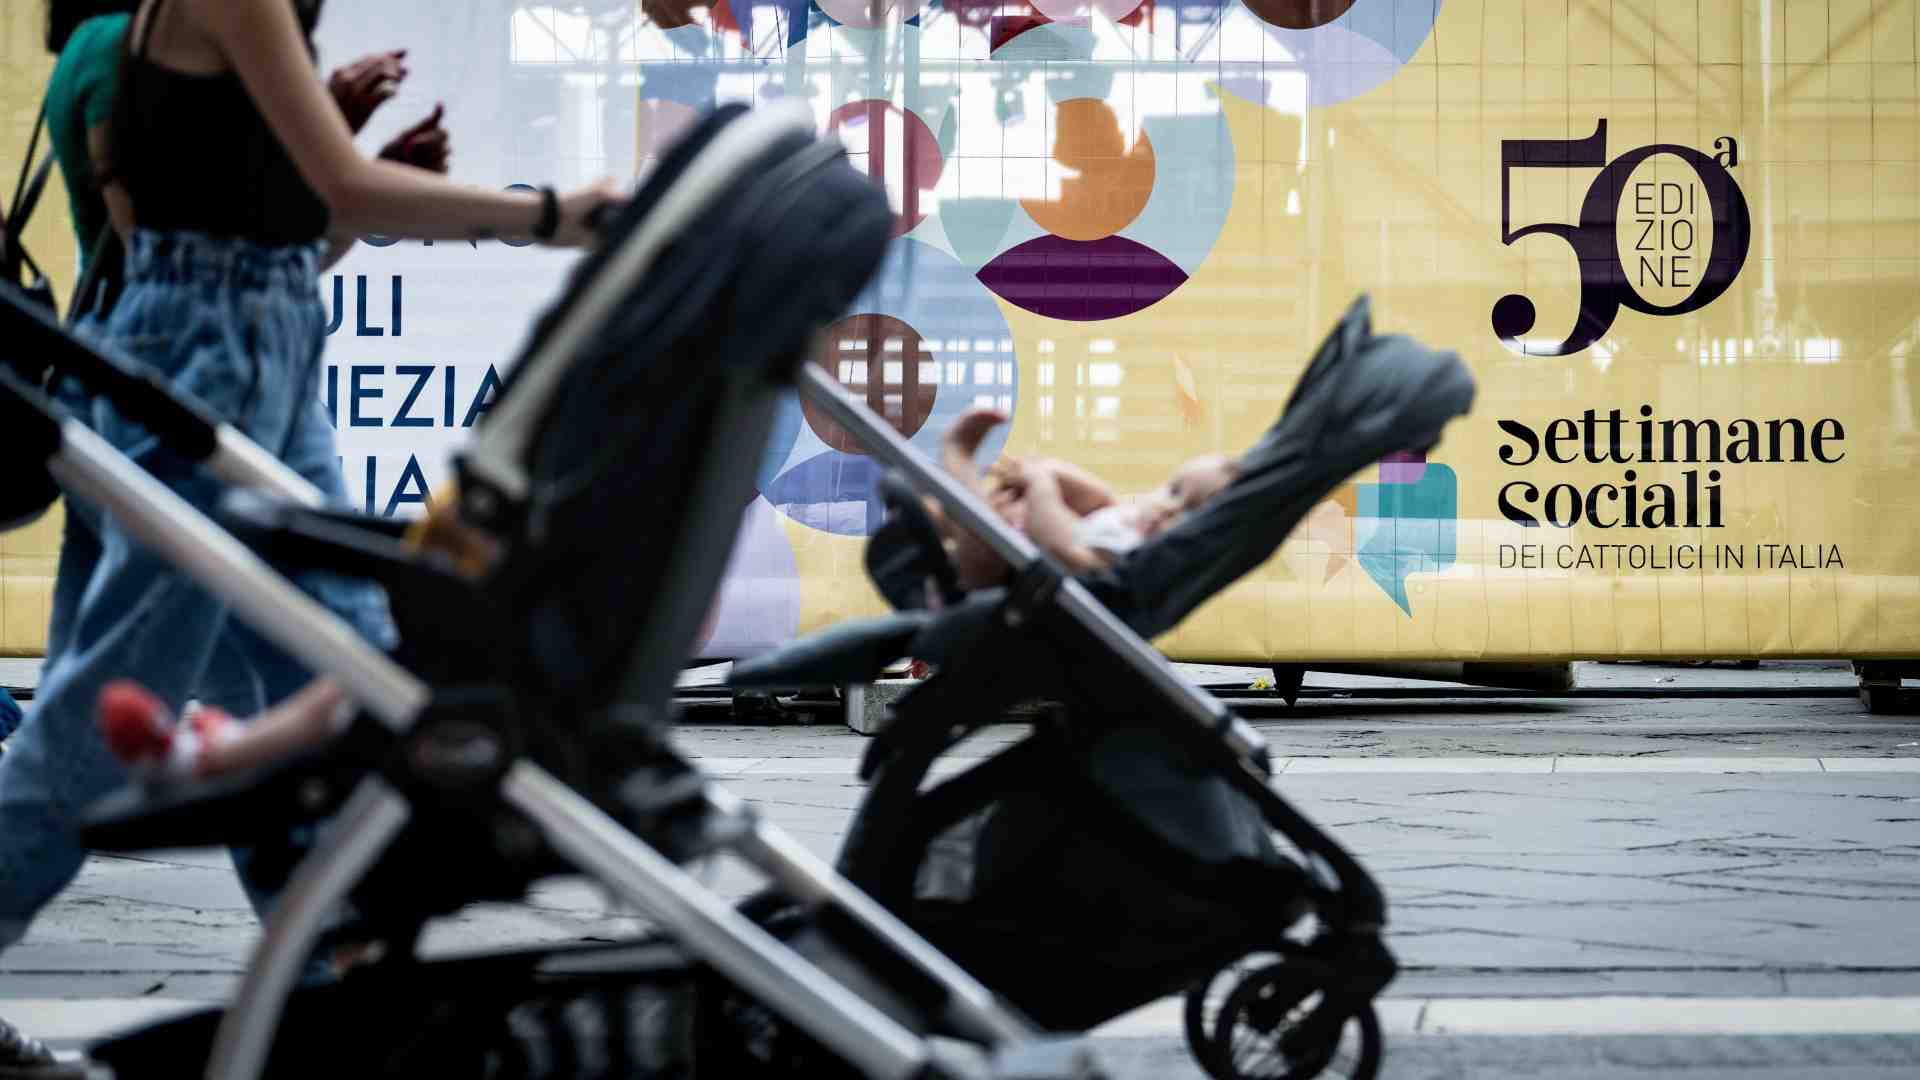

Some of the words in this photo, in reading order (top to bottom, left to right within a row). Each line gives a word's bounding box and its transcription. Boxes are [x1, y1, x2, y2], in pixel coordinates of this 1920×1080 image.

[1499, 544, 1544, 570] DEI
[1556, 544, 1703, 570] CATTOLICI
[1716, 544, 1744, 570] IN
[1757, 544, 1845, 570] ITALIA
